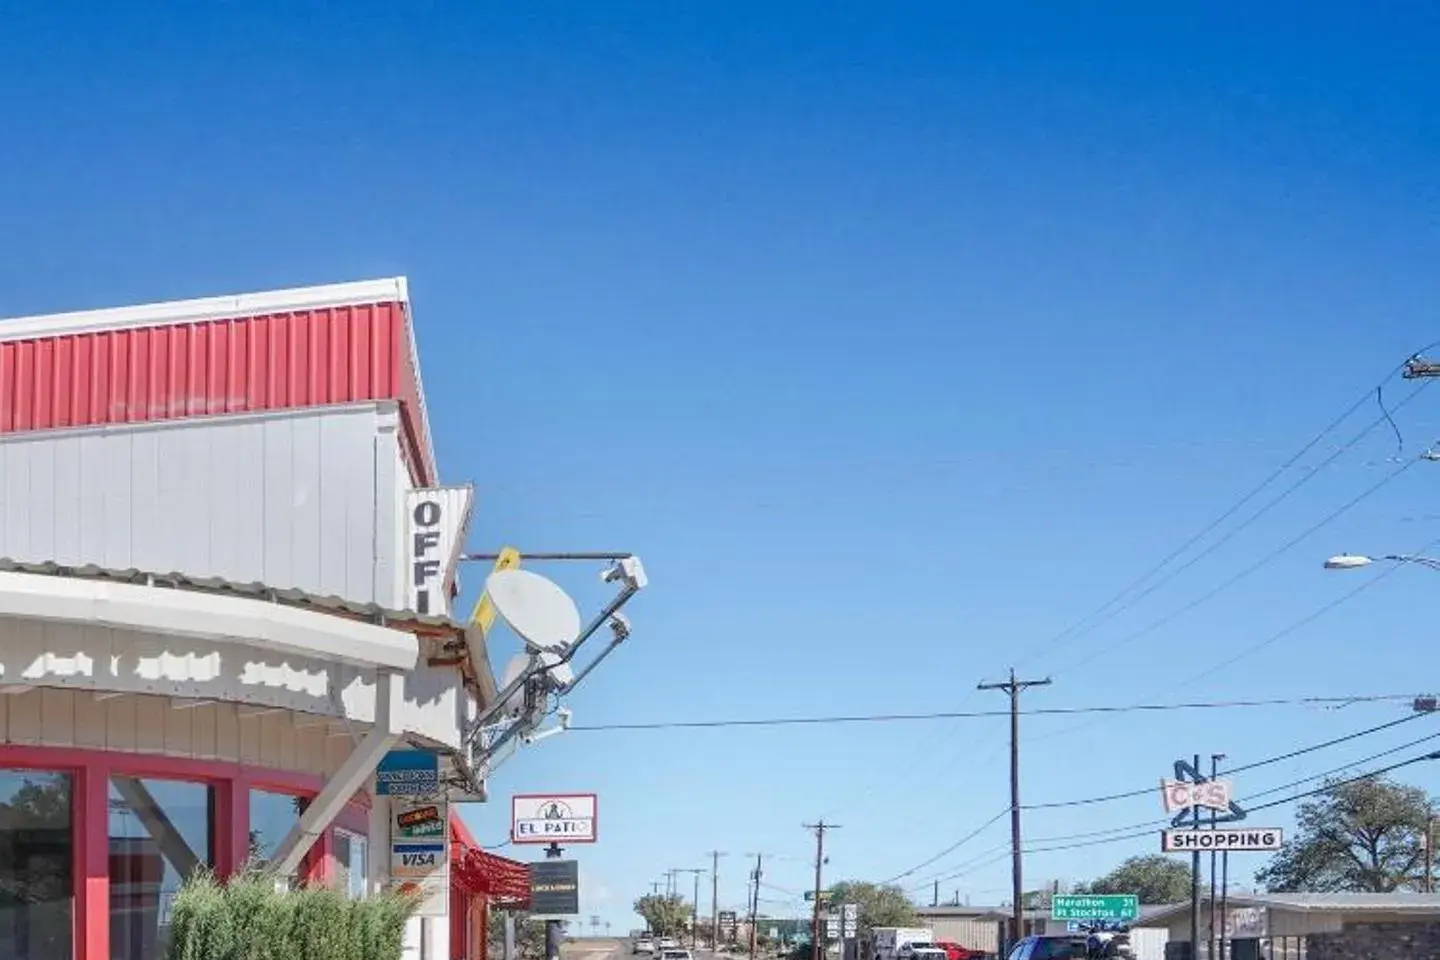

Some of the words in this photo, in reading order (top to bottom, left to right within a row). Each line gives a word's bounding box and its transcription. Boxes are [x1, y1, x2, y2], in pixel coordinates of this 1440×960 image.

[520, 823, 538, 834] EL
[1173, 833, 1275, 847] SHOPPING
[402, 853, 435, 866] VISA
[1057, 898, 1105, 907] Marathon
